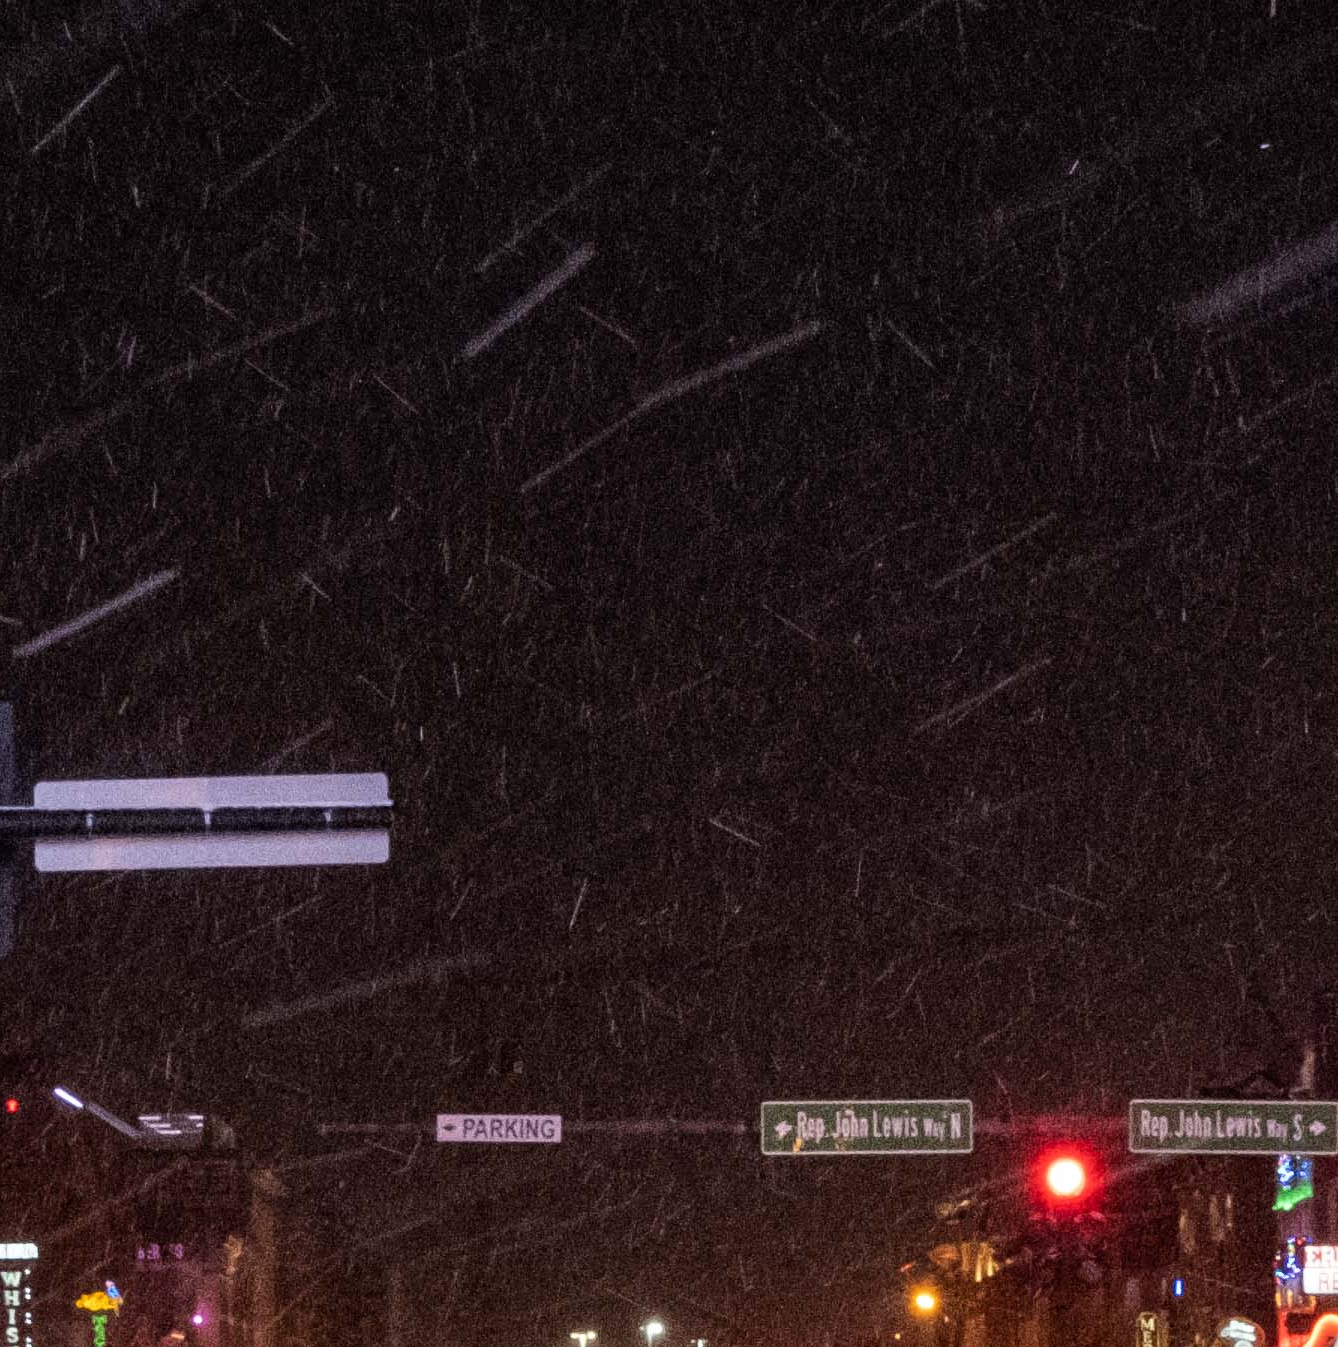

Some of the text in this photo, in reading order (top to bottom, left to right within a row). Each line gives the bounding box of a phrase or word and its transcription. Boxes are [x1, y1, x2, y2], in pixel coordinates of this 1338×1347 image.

[462, 1118, 555, 1139] PARKING
[796, 1110, 962, 1143] Rep. John Lewis Way N
[1140, 1110, 1303, 1143] Rep. John Lewis Way S
